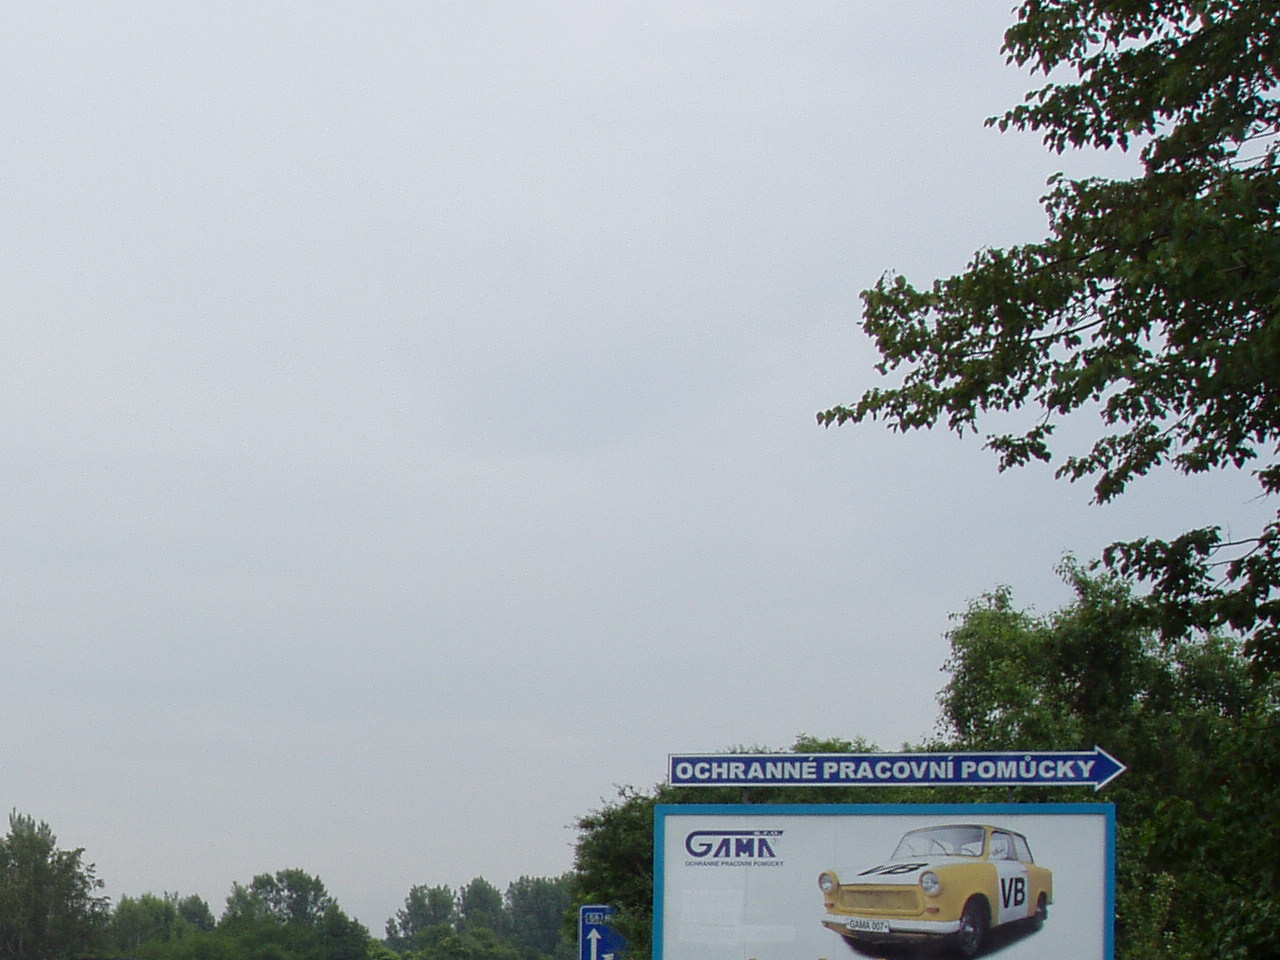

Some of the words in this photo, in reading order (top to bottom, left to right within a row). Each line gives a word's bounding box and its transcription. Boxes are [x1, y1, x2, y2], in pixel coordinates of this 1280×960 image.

[675, 756, 817, 779] OCHRANNÉ
[823, 756, 955, 779] PRACOVNÍ
[961, 755, 1096, 779] POMŮCKY
[685, 830, 783, 858] GAMA
[1001, 877, 1026, 908] VB
[850, 919, 870, 930] GAMA
